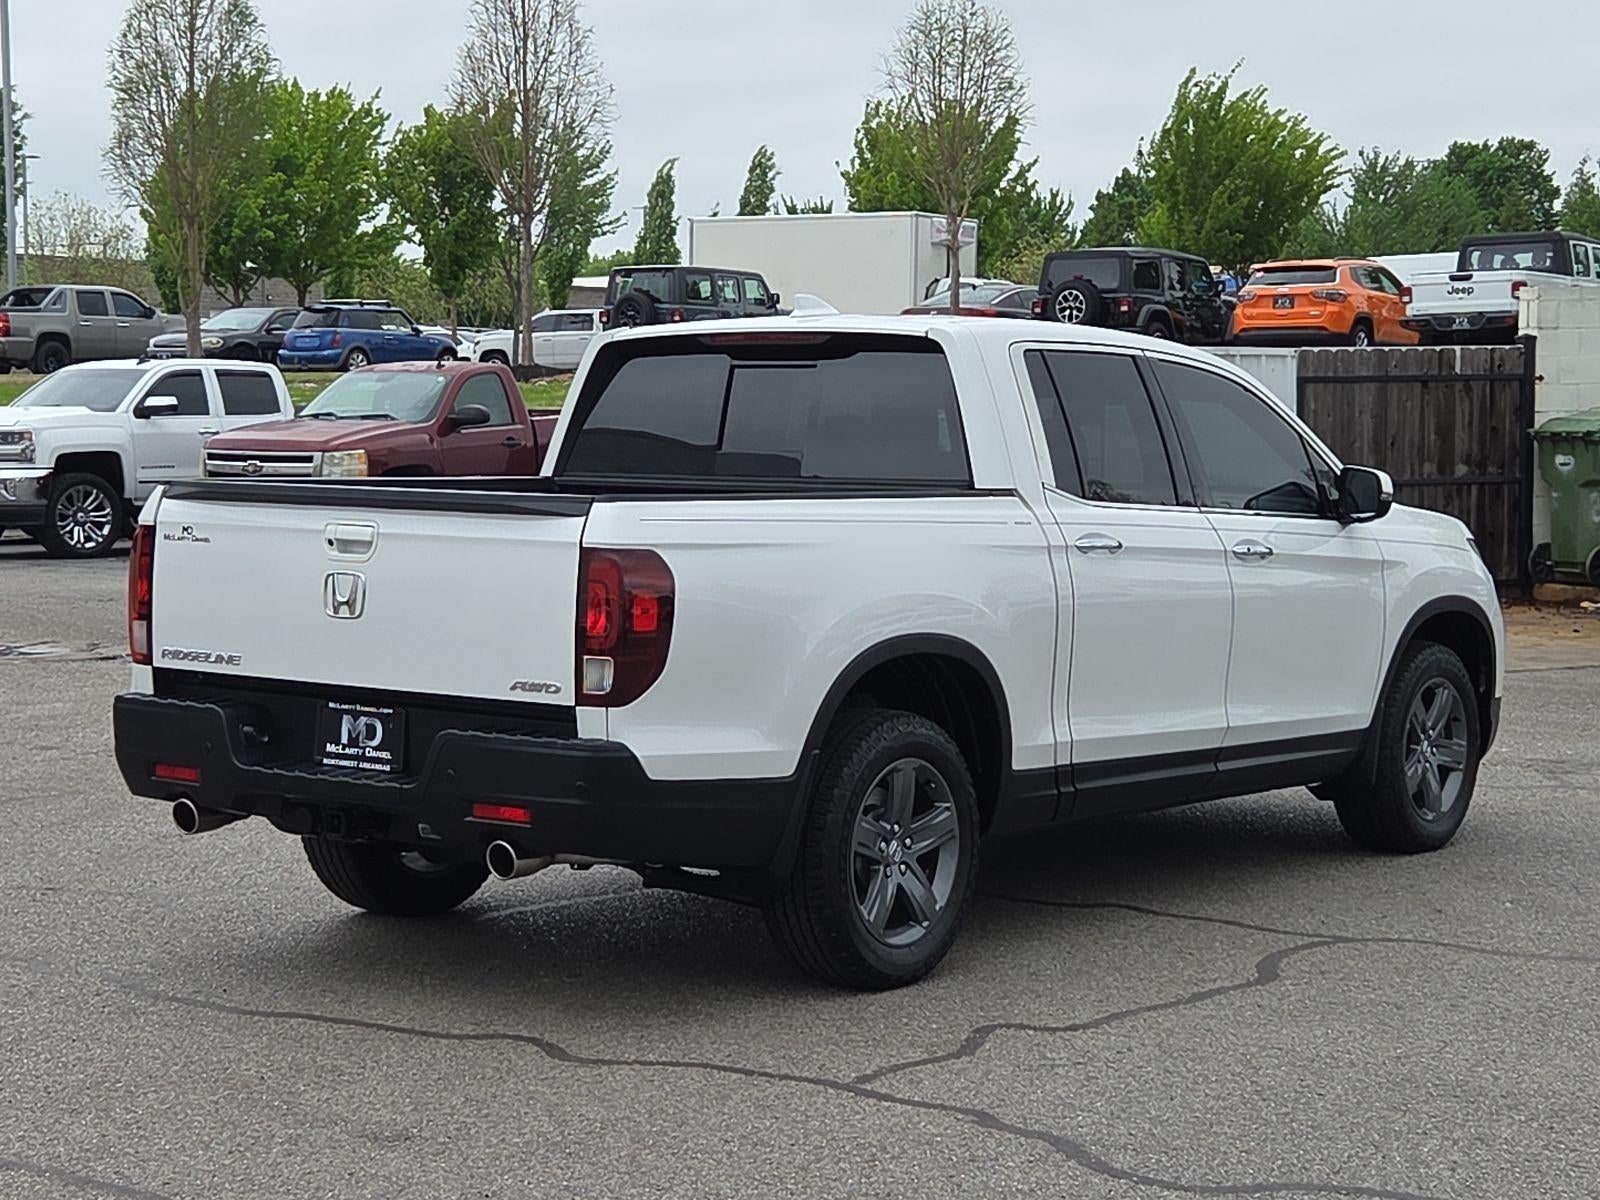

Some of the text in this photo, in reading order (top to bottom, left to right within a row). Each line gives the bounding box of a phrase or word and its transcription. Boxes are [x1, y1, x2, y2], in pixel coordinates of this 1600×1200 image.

[1447, 285, 1474, 296] Jeep
[161, 648, 242, 666] RIDGELINE
[509, 680, 562, 695] AWD
